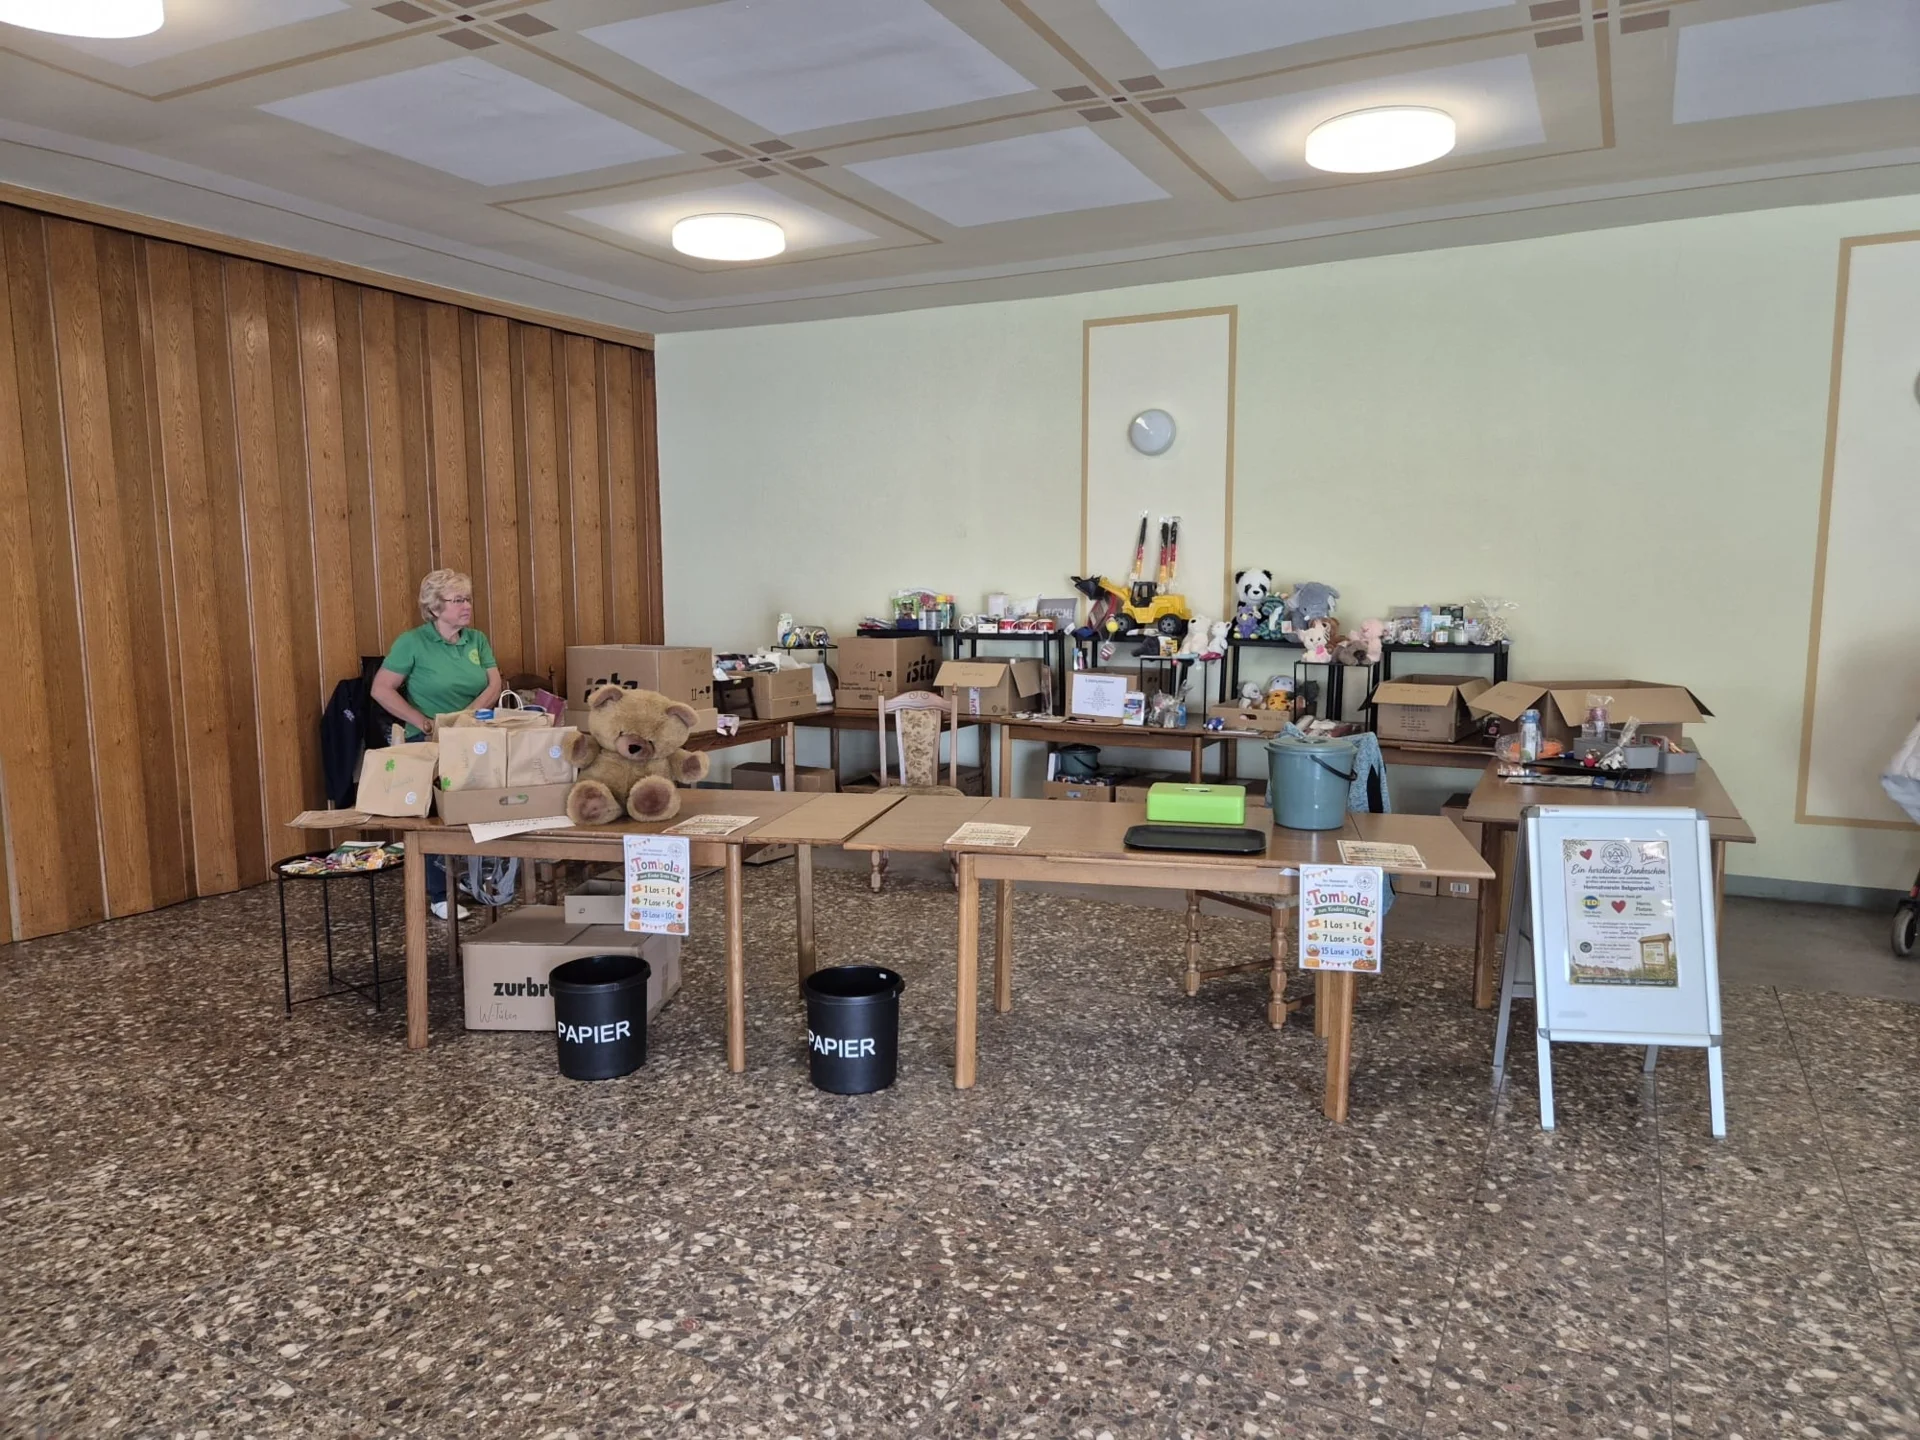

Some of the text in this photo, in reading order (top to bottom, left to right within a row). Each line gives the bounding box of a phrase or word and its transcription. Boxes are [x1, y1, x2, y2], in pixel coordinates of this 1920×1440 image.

[906, 654, 936, 684] ista
[631, 857, 680, 873] Tombola
[1571, 863, 1585, 875] Ein
[644, 885, 648, 894] 1
[649, 885, 660, 894] Los
[648, 899, 661, 907] Lose
[1307, 889, 1369, 907] Tombola
[1324, 919, 1328, 929] 1
[1330, 920, 1343, 929] Los
[1322, 933, 1328, 942] 7
[1330, 935, 1345, 943] Lose
[1321, 947, 1329, 955] 15
[557, 1020, 631, 1044] PAPIER
[808, 1029, 876, 1058] PAPIER
